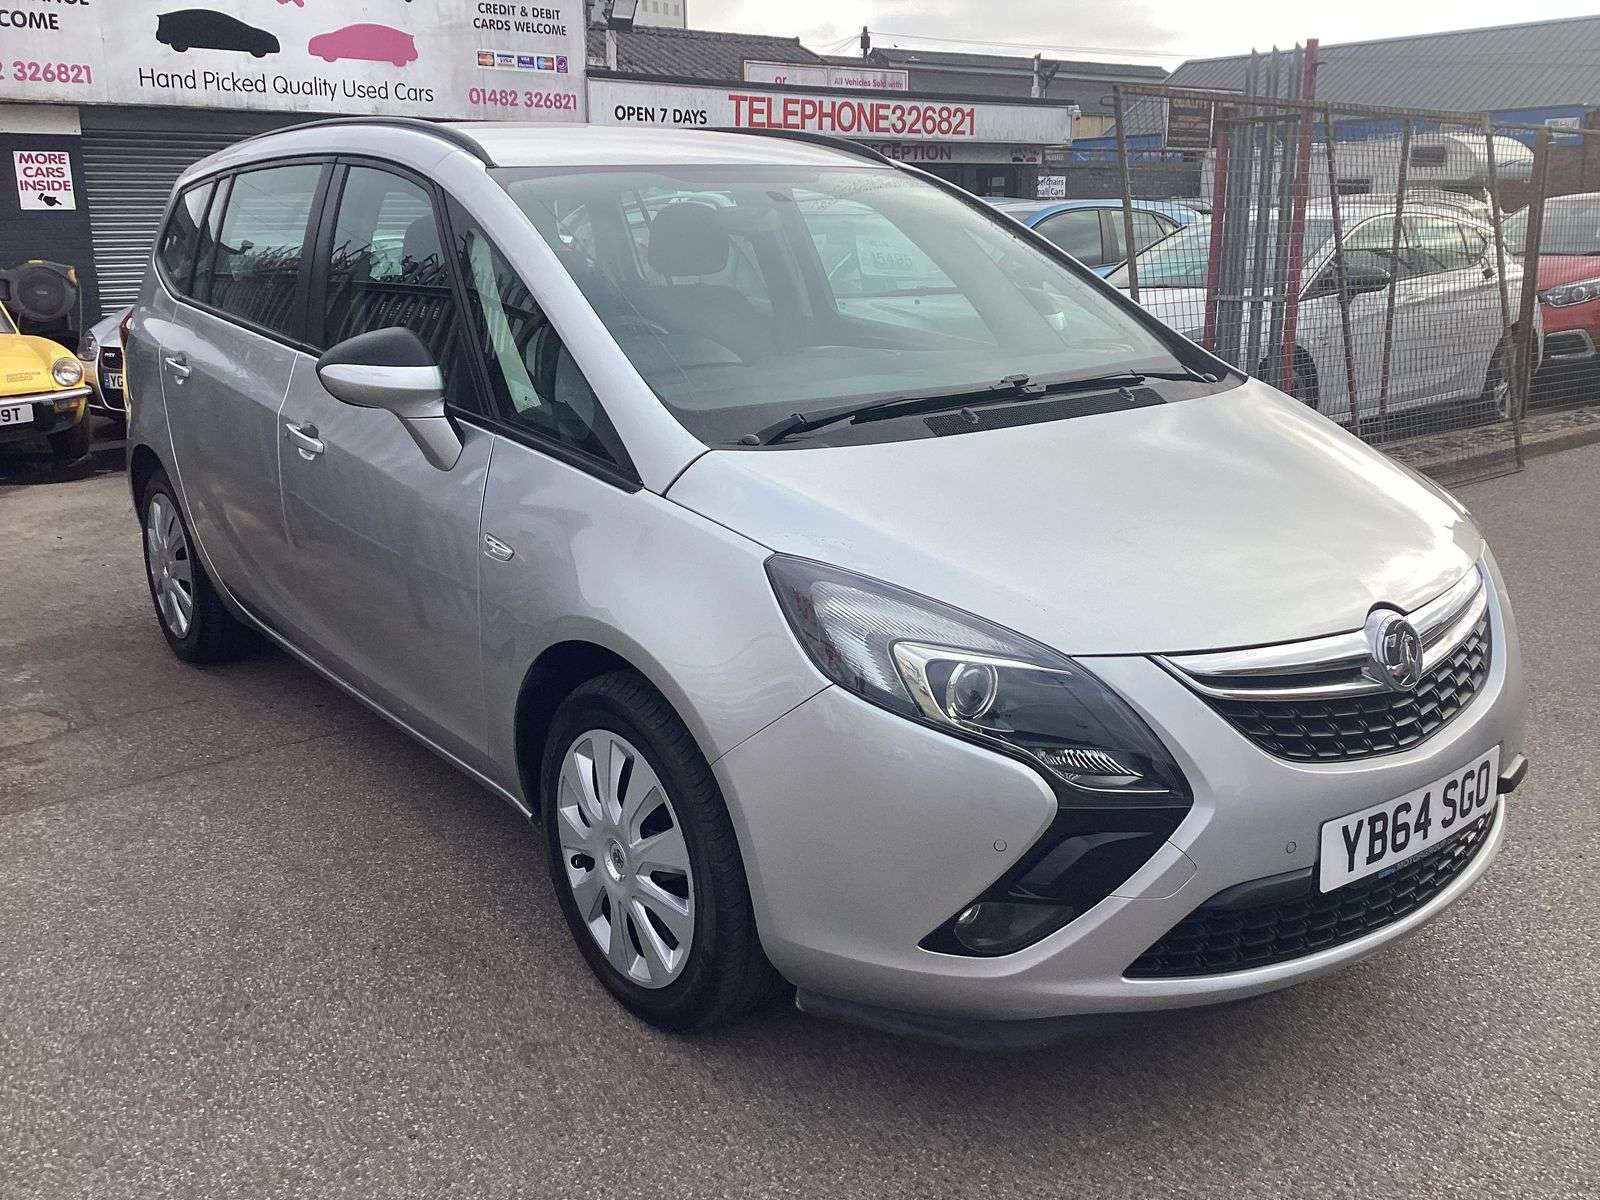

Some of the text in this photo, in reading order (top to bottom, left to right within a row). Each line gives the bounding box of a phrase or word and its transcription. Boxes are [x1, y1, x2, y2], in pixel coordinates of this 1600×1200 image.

[478, 3, 560, 20] CREDIT & DEBIT
[473, 18, 567, 36] CARDS WELCOME
[12, 60, 92, 84] 326821
[138, 68, 434, 102] Hand Picked Quality Used Cars
[844, 77, 871, 87] Vehicles
[469, 87, 577, 110] 01482 326821
[614, 105, 707, 125] OPEN 7 DAYS
[19, 153, 66, 164] MORE
[868, 142, 952, 160] CEPTION
[23, 166, 65, 178] CARS
[19, 180, 71, 191] INSIDE
[0, 407, 21, 422] 9T
[1341, 791, 1432, 873] YB64
[1441, 759, 1491, 829] SGO
